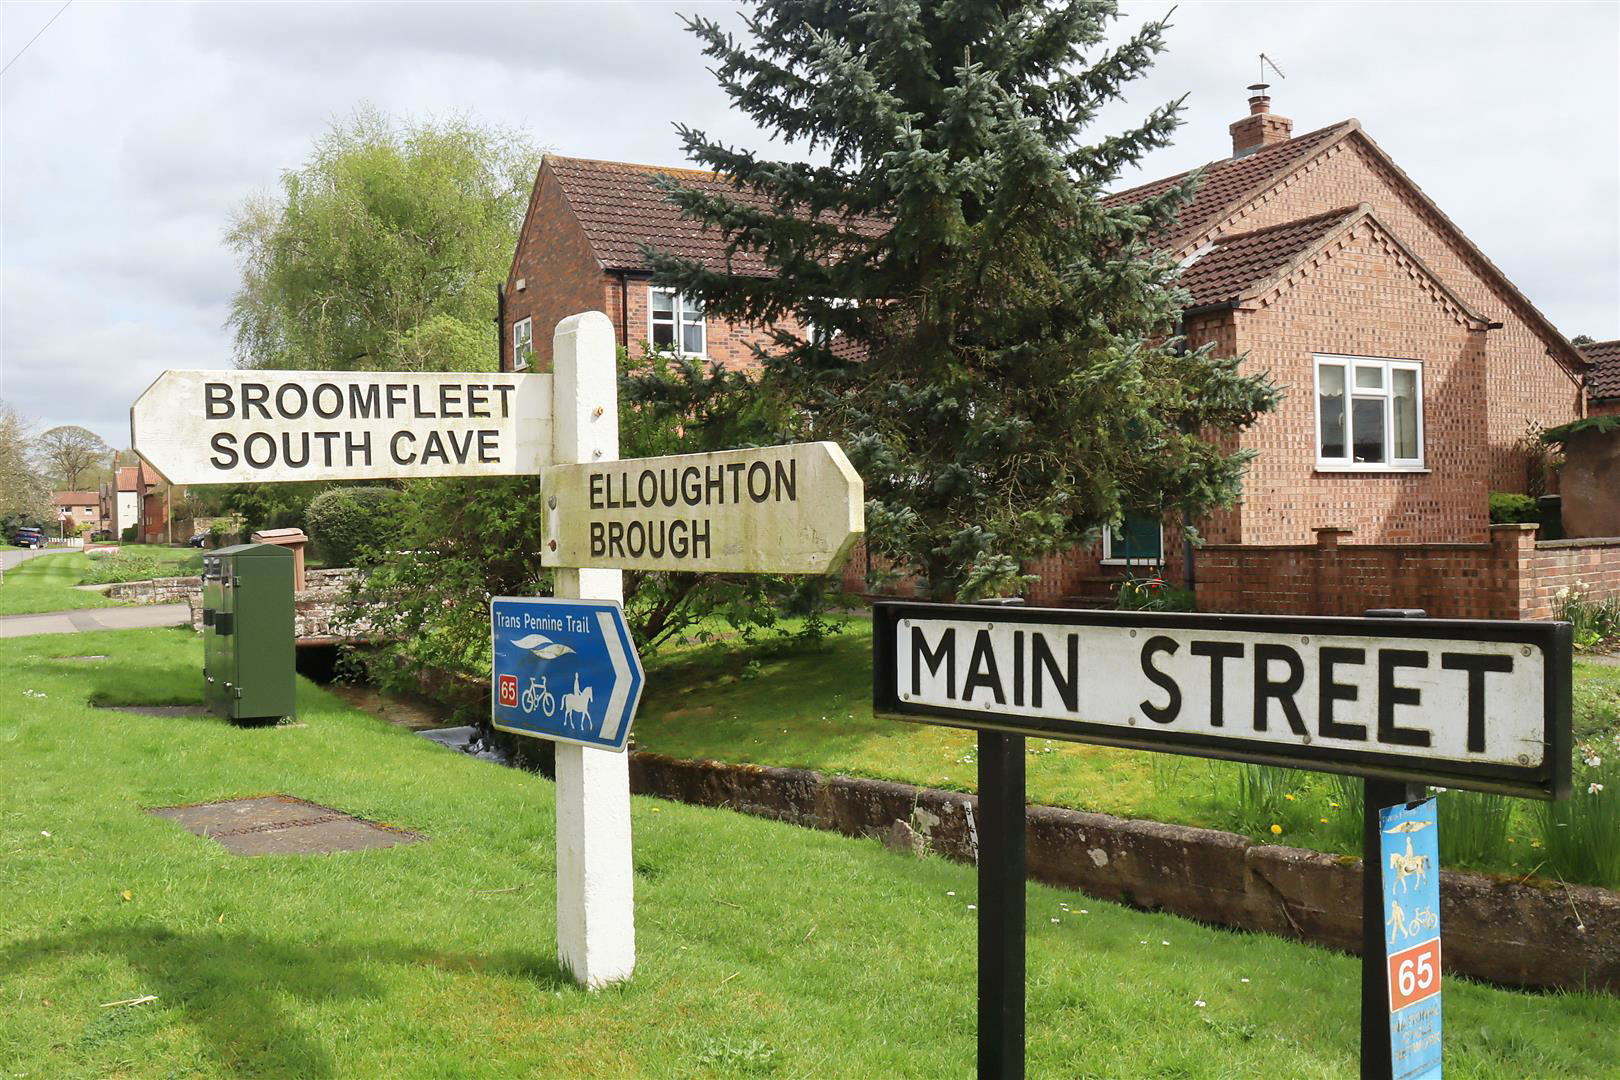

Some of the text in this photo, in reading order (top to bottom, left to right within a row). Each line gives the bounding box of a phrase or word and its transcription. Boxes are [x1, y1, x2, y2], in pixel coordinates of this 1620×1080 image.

[205, 382, 516, 420] BROOMFLEET
[210, 430, 501, 470] SOUTH CAVE
[589, 458, 797, 510] ELLOUGHTON
[590, 520, 711, 559] BROUGH
[495, 611, 590, 634] Trans Pennine Trail
[501, 681, 516, 701] 65
[911, 626, 1515, 753] MAIN STREET
[1398, 951, 1433, 997] 65
